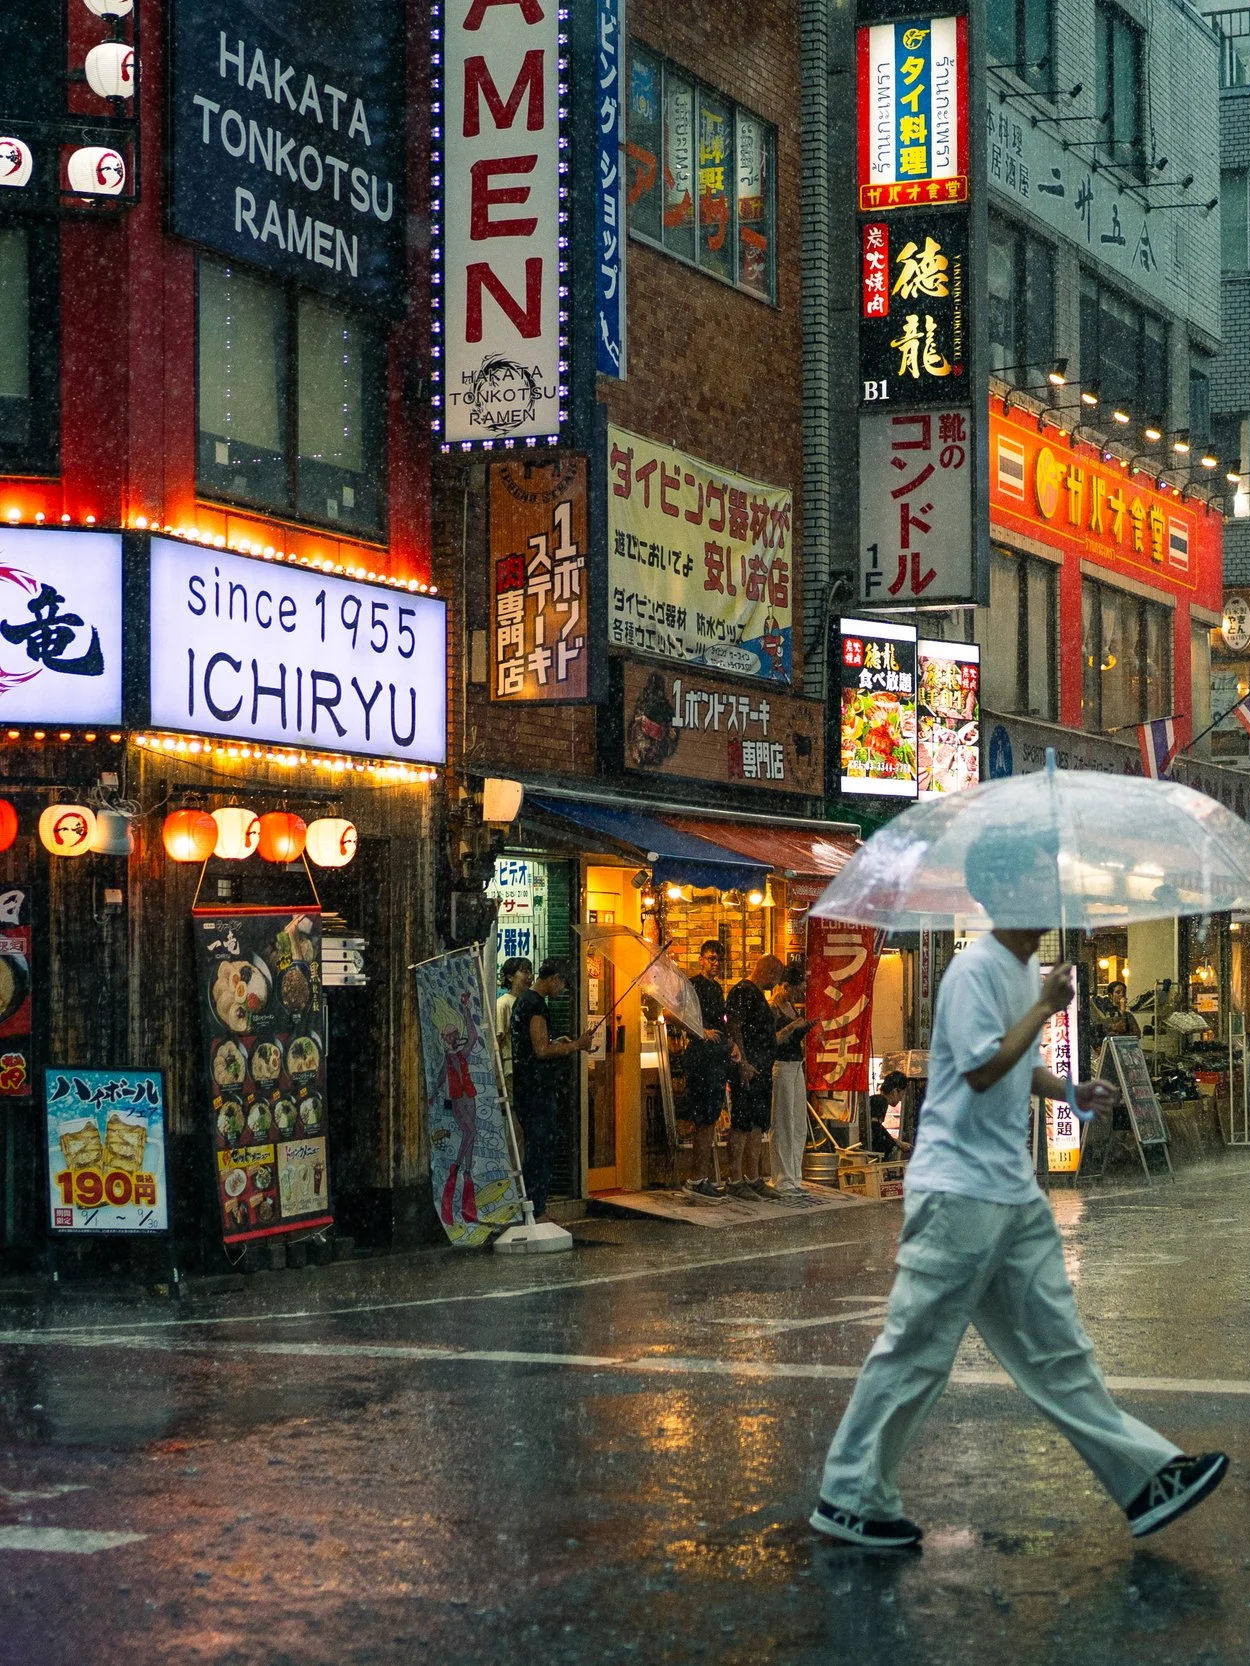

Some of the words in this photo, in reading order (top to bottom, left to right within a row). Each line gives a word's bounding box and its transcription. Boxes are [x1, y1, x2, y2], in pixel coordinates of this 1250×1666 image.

[219, 31, 372, 146] HAKATA
[900, 56, 928, 175] タイ料理
[193, 94, 394, 222] TONKOTSU
[868, 181, 961, 205] ガパオ食堂
[235, 186, 358, 278] RAMEN
[865, 227, 885, 314] 炭火焼肉
[449, 385, 557, 406] TONKOTSU
[461, 365, 544, 385] HAKATA
[864, 380, 889, 401] B1
[469, 408, 536, 426] RAMEN
[938, 412, 967, 471] 靴の
[610, 442, 791, 549] ダイビング器材が
[888, 413, 938, 597] コンドル
[1066, 463, 1166, 563] ガパオ食堂
[614, 528, 694, 578] 遊びにおいでよ
[703, 540, 790, 608] 安いお店
[865, 542, 883, 598] 1F
[188, 566, 297, 634] since
[316, 589, 416, 659] 1955
[527, 535, 552, 685] ステーキ
[554, 501, 585, 681] 1ポンド
[613, 586, 687, 632] ダイビング器材
[696, 612, 748, 644] 防水グッズ
[187, 647, 417, 748] ICHIRYU
[671, 679, 770, 736] 1ポンドステーキ
[858, 668, 913, 693] 食べ放題
[500, 861, 528, 887] ビデオ
[497, 928, 530, 957] 器材
[816, 933, 869, 1084] ランチ
[50, 1075, 160, 1110] ハイボール
[123, 1106, 159, 1118] フェア
[1058, 1151, 1073, 1163] B1
[57, 1171, 133, 1206] 190
[134, 1183, 157, 1206] 円
